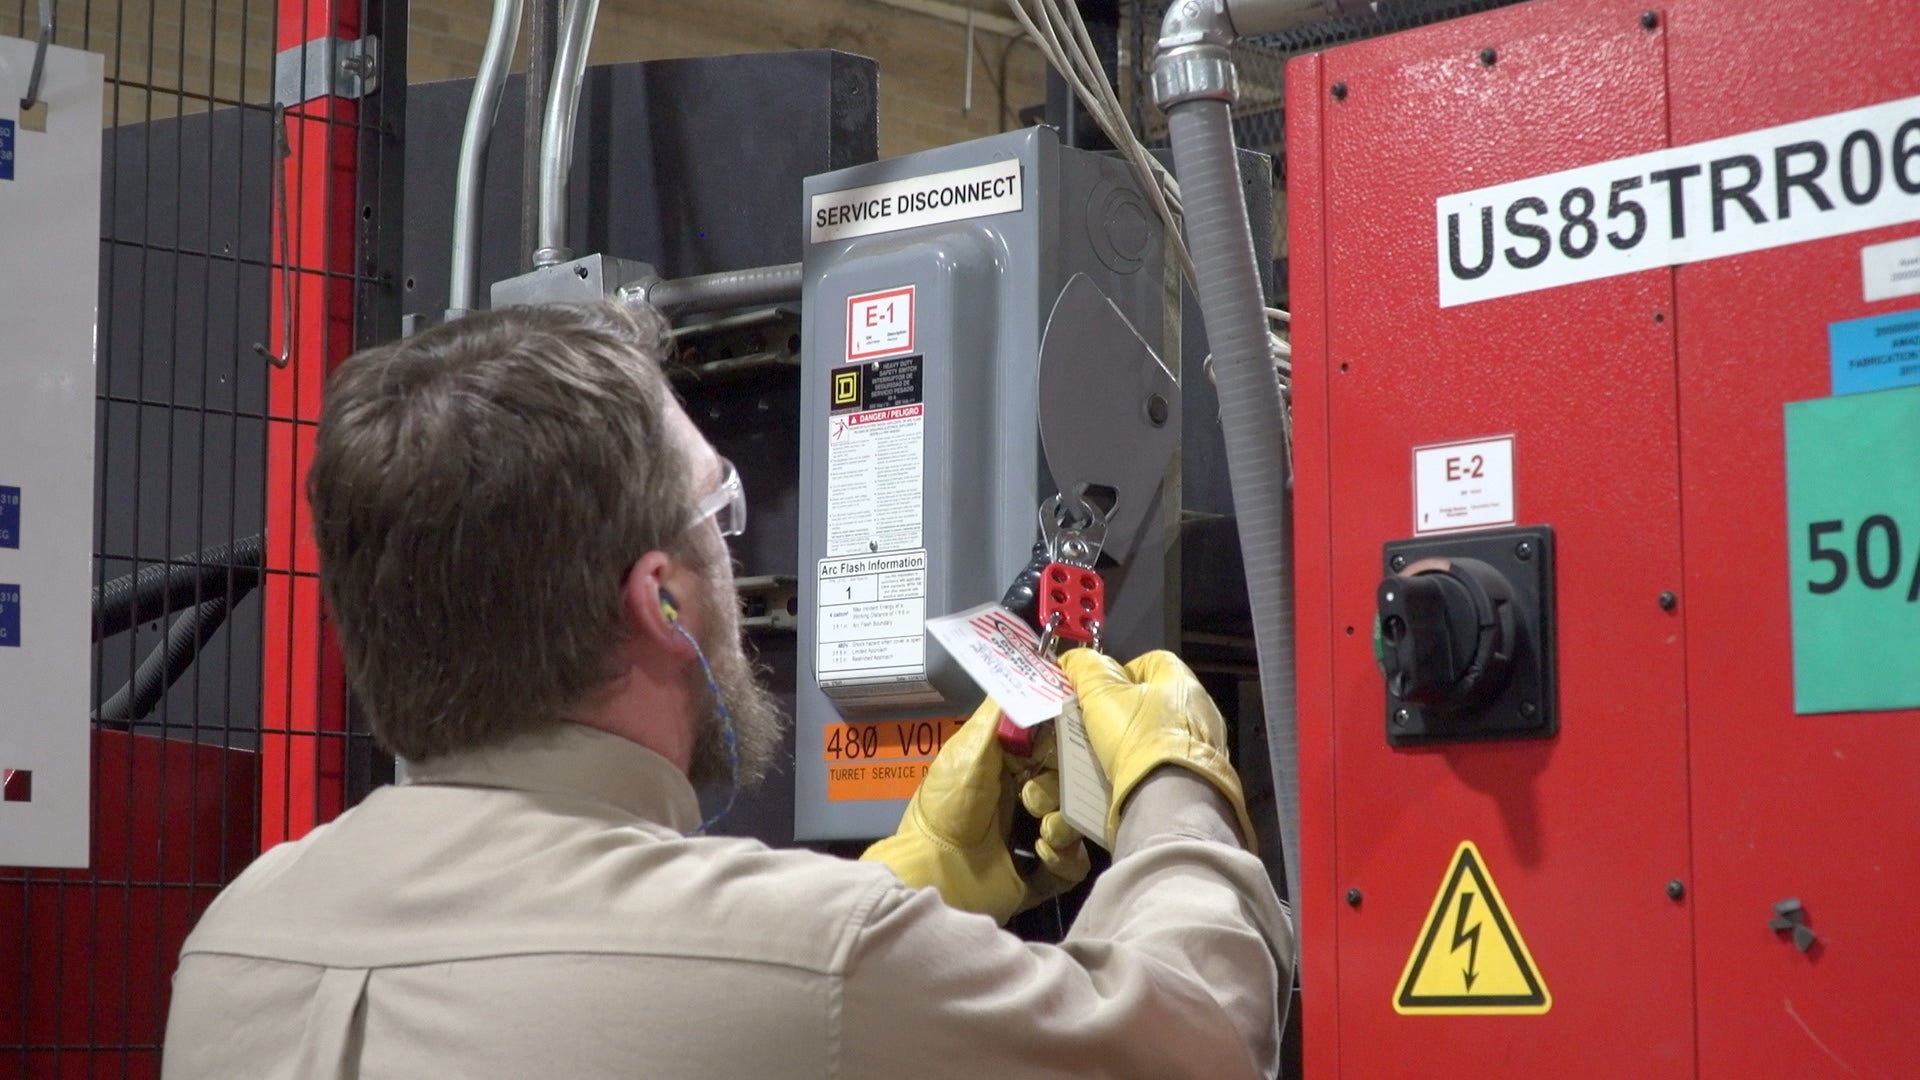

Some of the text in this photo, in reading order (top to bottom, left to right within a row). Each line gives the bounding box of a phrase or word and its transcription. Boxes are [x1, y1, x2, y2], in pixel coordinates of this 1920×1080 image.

[816, 175, 1016, 228] SERVICE DISCONNECT
[1447, 118, 1920, 280] US85TRR06
[866, 302, 894, 327] E-1
[860, 411, 887, 423] DANGER
[891, 407, 920, 418] PELIGRO
[1446, 455, 1484, 481] E-2
[822, 557, 923, 576] Arc Flash Information
[846, 586, 851, 600] 1
[827, 725, 878, 759] 480
[830, 768, 866, 781] TURRET
[872, 766, 915, 780] SERVICE
